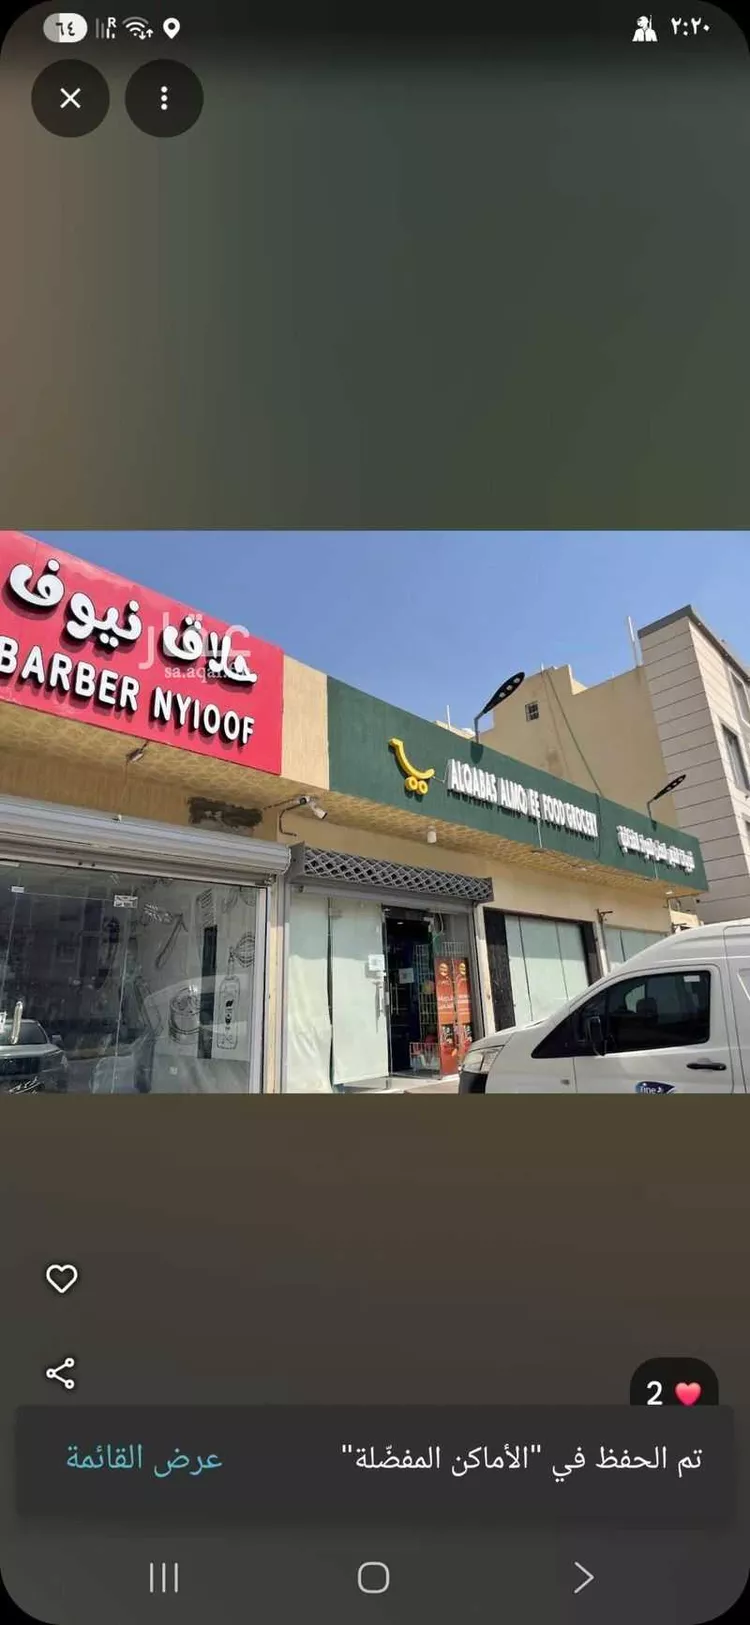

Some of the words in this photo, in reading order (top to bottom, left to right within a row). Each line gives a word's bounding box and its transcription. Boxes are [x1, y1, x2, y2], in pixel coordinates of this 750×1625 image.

[9, 558, 144, 648] نيوف
[162, 615, 258, 683] حلاق
[0, 635, 141, 712] BARBER
[153, 686, 256, 745] NYIOOF
[541, 794, 566, 826] FOOD
